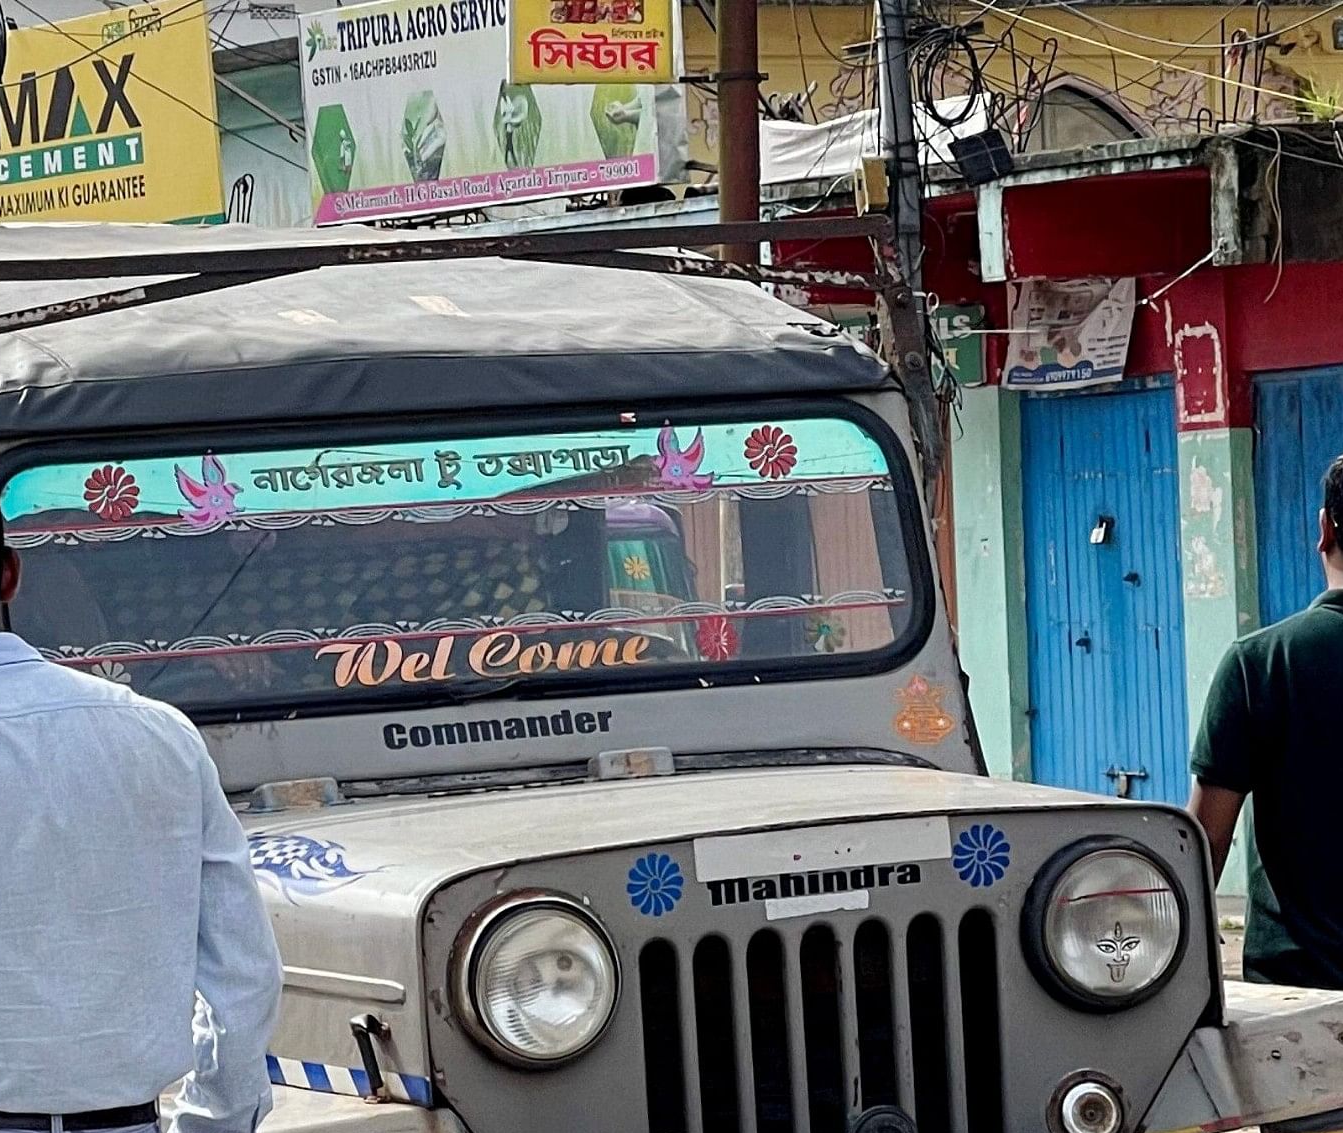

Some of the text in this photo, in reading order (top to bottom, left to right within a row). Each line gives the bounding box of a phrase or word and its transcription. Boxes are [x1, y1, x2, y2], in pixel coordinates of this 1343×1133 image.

[337, 11, 403, 52] TRIPURA
[406, 2, 447, 41] AGRO
[527, 27, 660, 72] সিষ্টার
[312, 65, 341, 86] GSTIN
[58, 185, 71, 208] KI
[72, 174, 146, 207] GUARANTEE
[497, 172, 542, 197] Agartala
[546, 167, 588, 190] Tripura
[599, 161, 640, 181] 799001
[433, 449, 462, 490] টু
[314, 630, 651, 688] Wel Come
[381, 708, 613, 751] Commander
[707, 860, 922, 907] Mahindra
